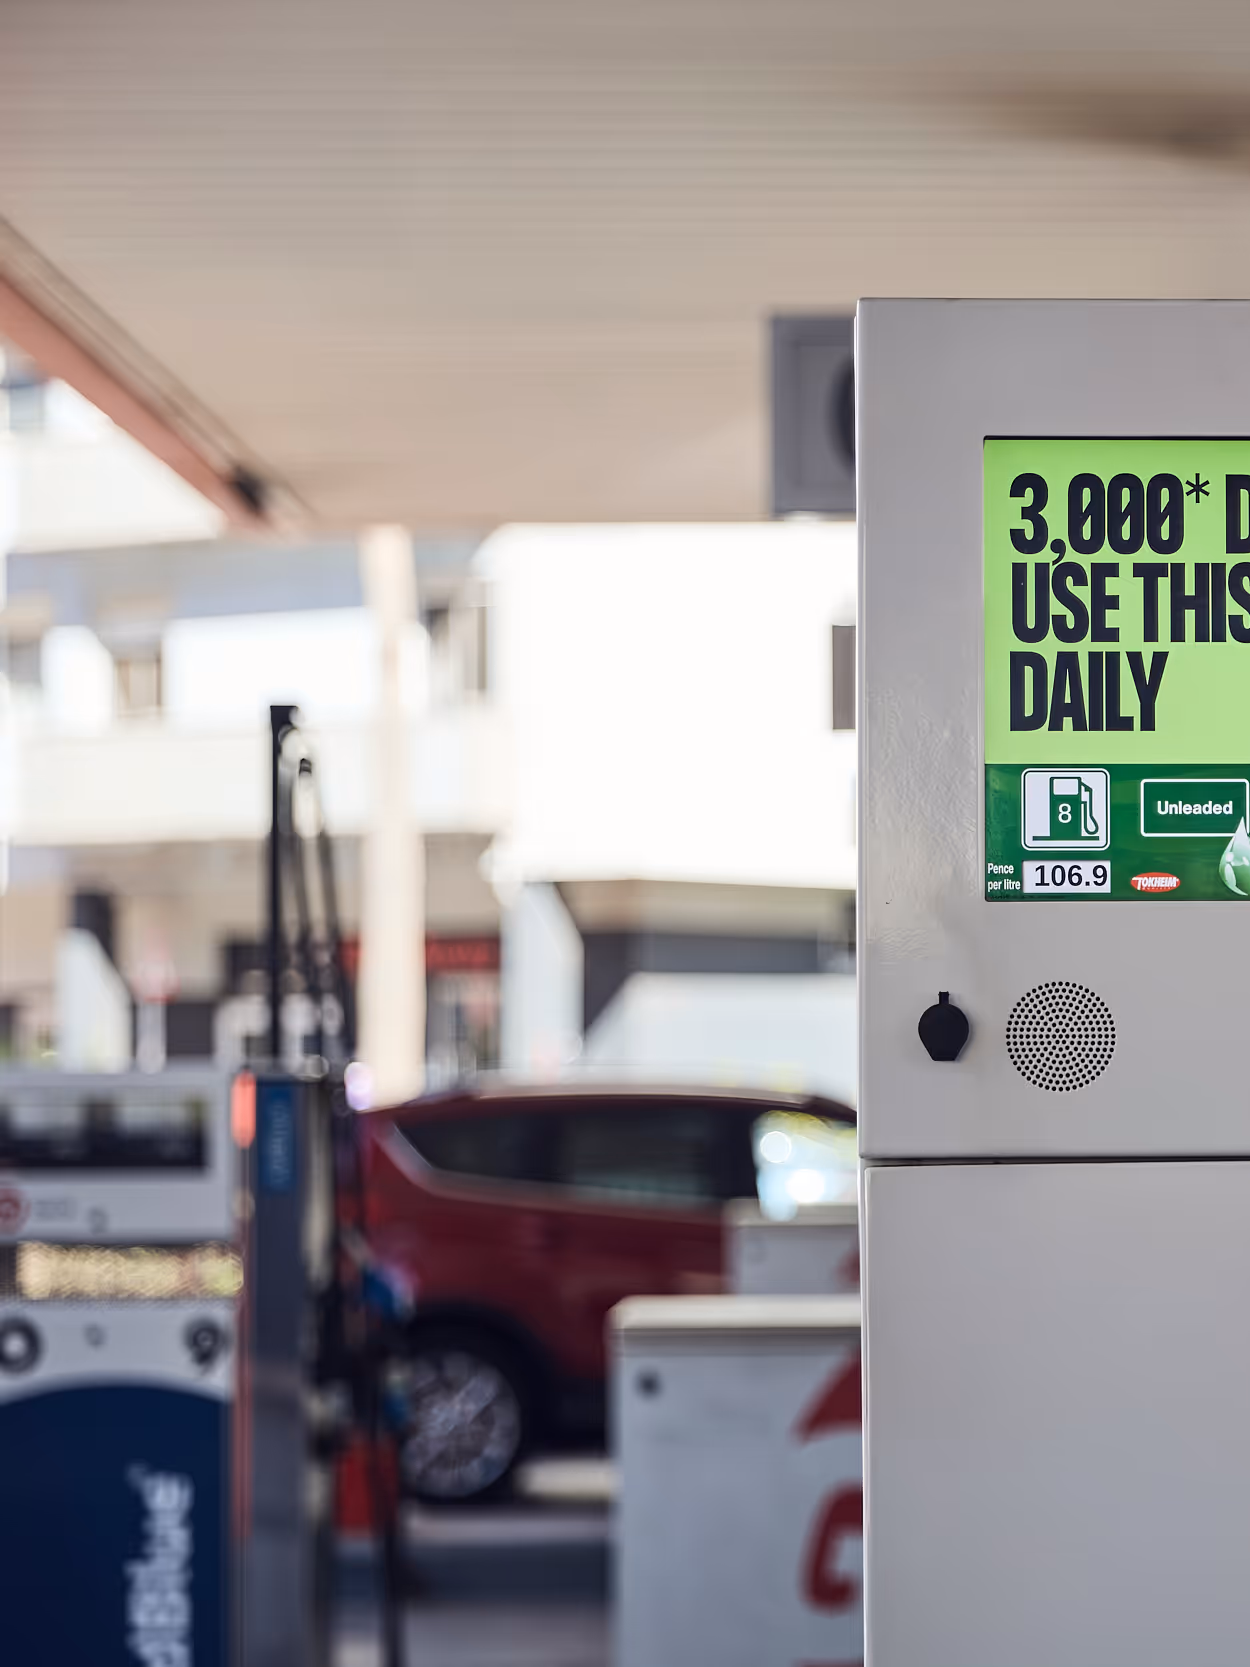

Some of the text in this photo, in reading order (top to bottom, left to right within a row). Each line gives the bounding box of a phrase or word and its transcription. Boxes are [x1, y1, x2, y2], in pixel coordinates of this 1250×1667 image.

[1012, 563, 1119, 643] USE
[1010, 651, 1169, 731] DAILY
[1059, 804, 1071, 823] 8
[1158, 801, 1232, 815] Unleaded
[988, 863, 1014, 874] Pence
[1036, 865, 1107, 886] 106.9
[988, 879, 1020, 892] per litre
[1132, 877, 1177, 890] TOKHEIM
